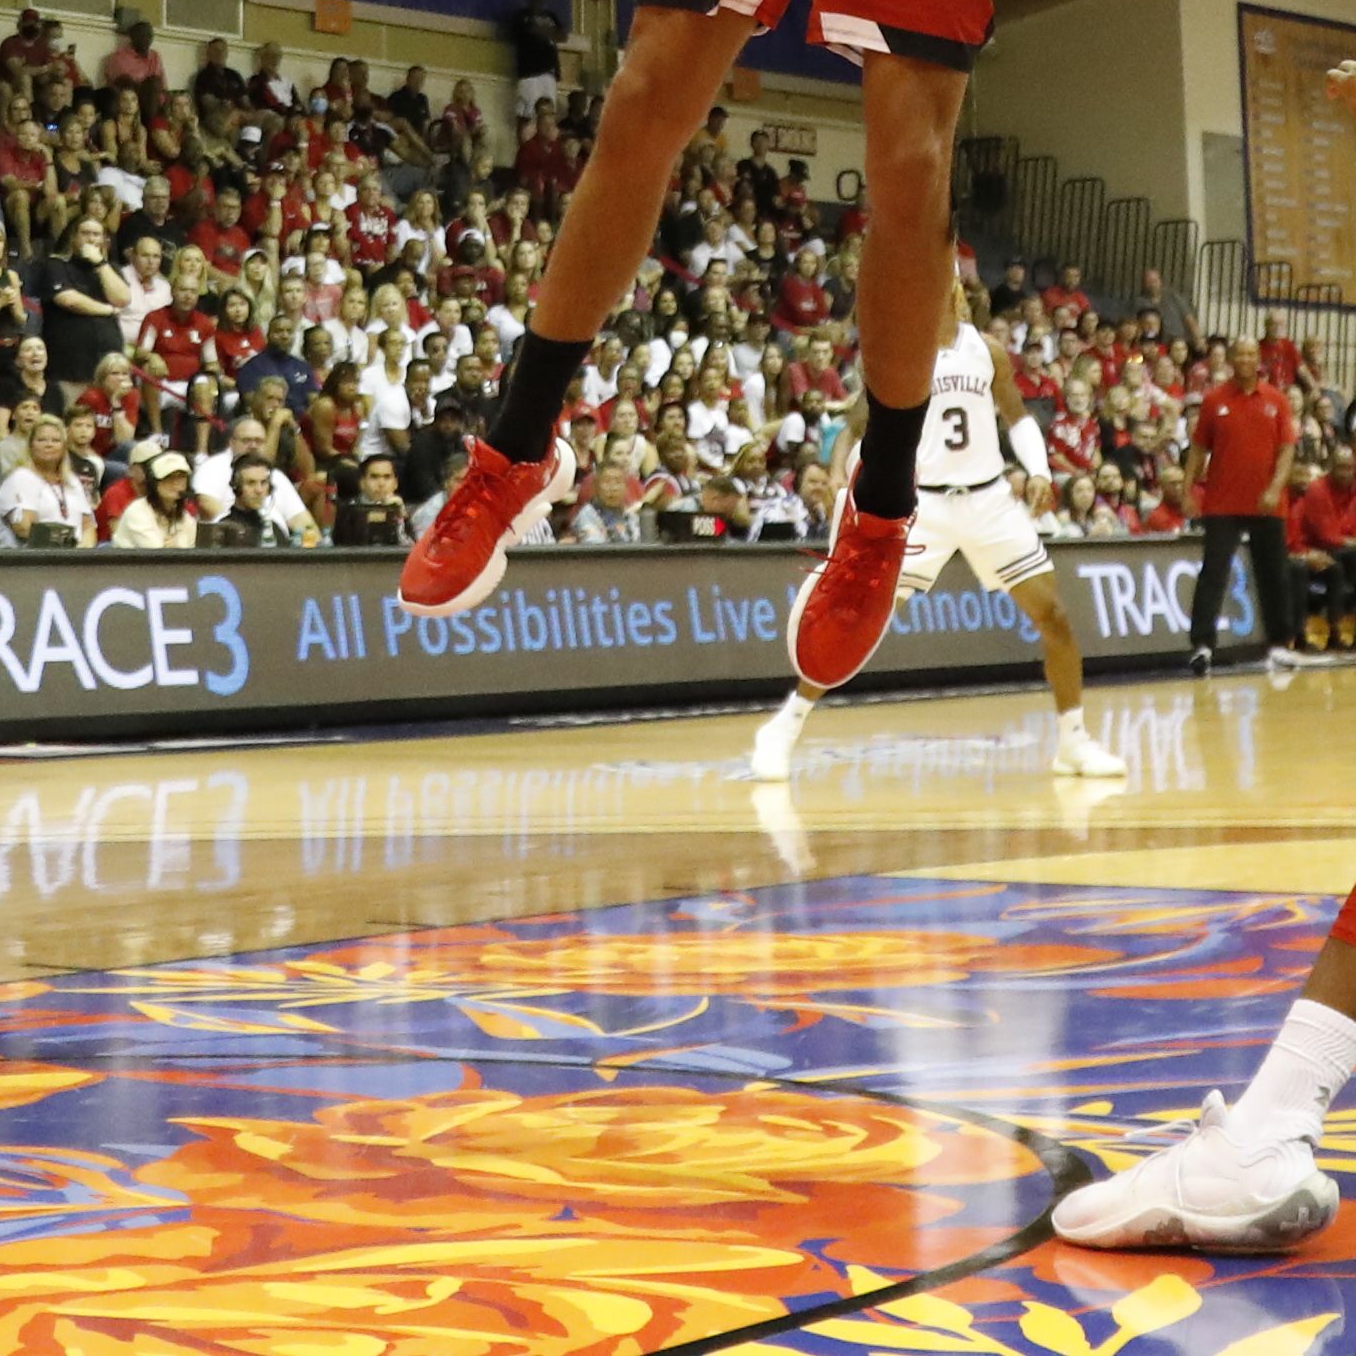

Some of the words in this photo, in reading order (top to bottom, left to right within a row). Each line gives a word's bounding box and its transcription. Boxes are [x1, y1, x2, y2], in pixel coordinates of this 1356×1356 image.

[931, 374, 988, 397] UISVILLE
[942, 406, 971, 452] 3
[296, 594, 368, 662] All
[381, 586, 678, 658] Possibilities
[686, 583, 779, 643] Live
[1077, 554, 1255, 638] TRAC3
